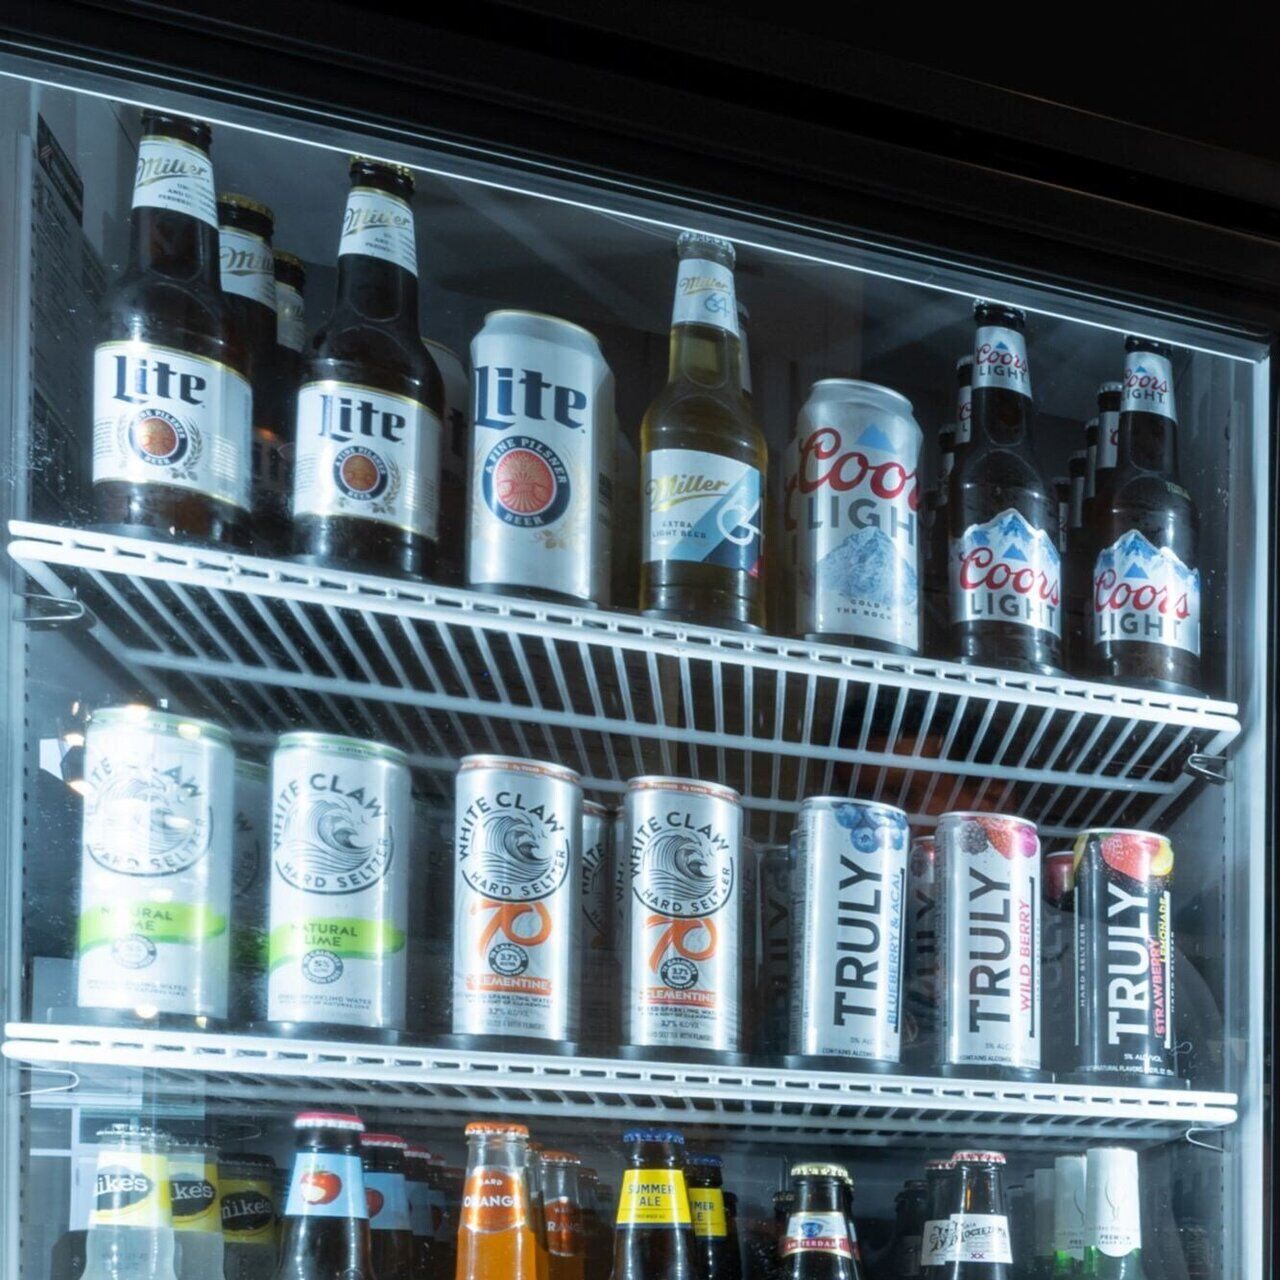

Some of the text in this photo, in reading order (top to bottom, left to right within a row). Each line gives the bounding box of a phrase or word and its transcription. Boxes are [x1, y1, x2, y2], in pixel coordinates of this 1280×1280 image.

[113, 356, 206, 405] Lite
[975, 343, 1029, 377] Coors
[979, 367, 1027, 380] LIGHT
[317, 394, 406, 443] Lite
[473, 366, 588, 431] Lite
[646, 474, 730, 504] Miller
[959, 546, 1060, 607] Coors
[1093, 568, 1190, 619] Coors
[309, 773, 389, 821] CLAW
[459, 791, 565, 862] WHITE CLAW
[631, 811, 730, 879] WHITE CLAW
[470, 849, 565, 897] HARD SELTZER
[643, 866, 731, 914] HARD SELTZER
[470, 899, 552, 960] 70
[646, 914, 718, 974] 70
[833, 854, 883, 1027] TRULY
[968, 866, 1012, 1033] TRULY
[1159, 895, 1169, 963] LEMONADE
[1020, 899, 1033, 1013] WILD BERRY
[1108, 882, 1151, 1045] TRULY
[464, 1196, 521, 1208] ORANGE
[628, 1183, 675, 1195] SUMMER
[639, 1196, 661, 1207] ALE
